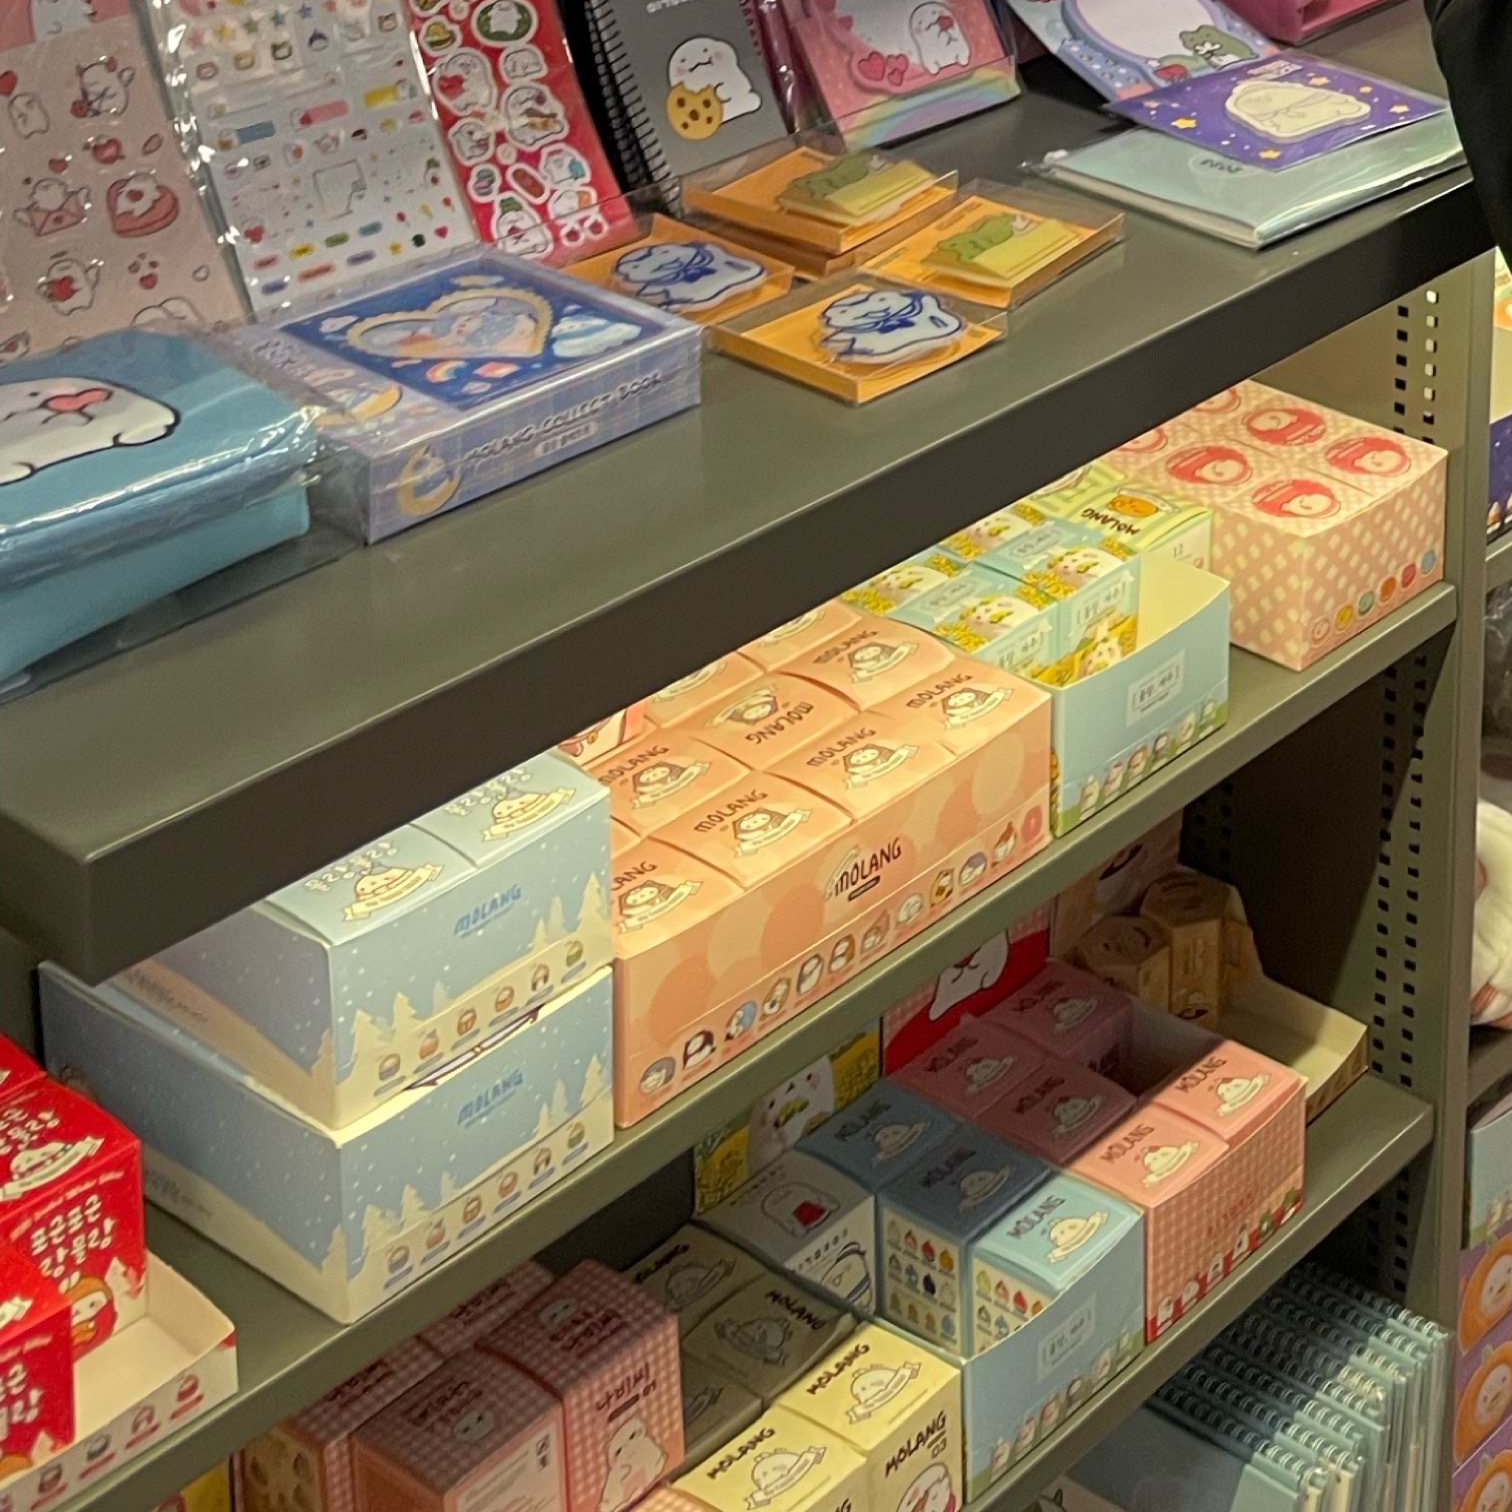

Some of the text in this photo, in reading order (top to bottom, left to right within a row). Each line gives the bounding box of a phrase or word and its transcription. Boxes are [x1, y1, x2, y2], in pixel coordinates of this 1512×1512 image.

[1081, 507, 1140, 537] MOLANG
[813, 629, 880, 667] MOLANG
[906, 672, 974, 712] MOLANG
[744, 700, 816, 746] MOLANG
[805, 726, 878, 769] MOLANG
[693, 788, 770, 836] MOLANG
[833, 836, 903, 898] MOLANG
[453, 884, 524, 938] MOLANG
[457, 1068, 525, 1125] MOLANG
[1174, 1055, 1227, 1094] MOLANG
[1098, 1122, 1156, 1167] MOLANG
[1006, 1193, 1066, 1243] MOLANG
[806, 1342, 870, 1396] MOLANG
[705, 1425, 776, 1481] MOLANG
[884, 1409, 948, 1478] MOLANG
